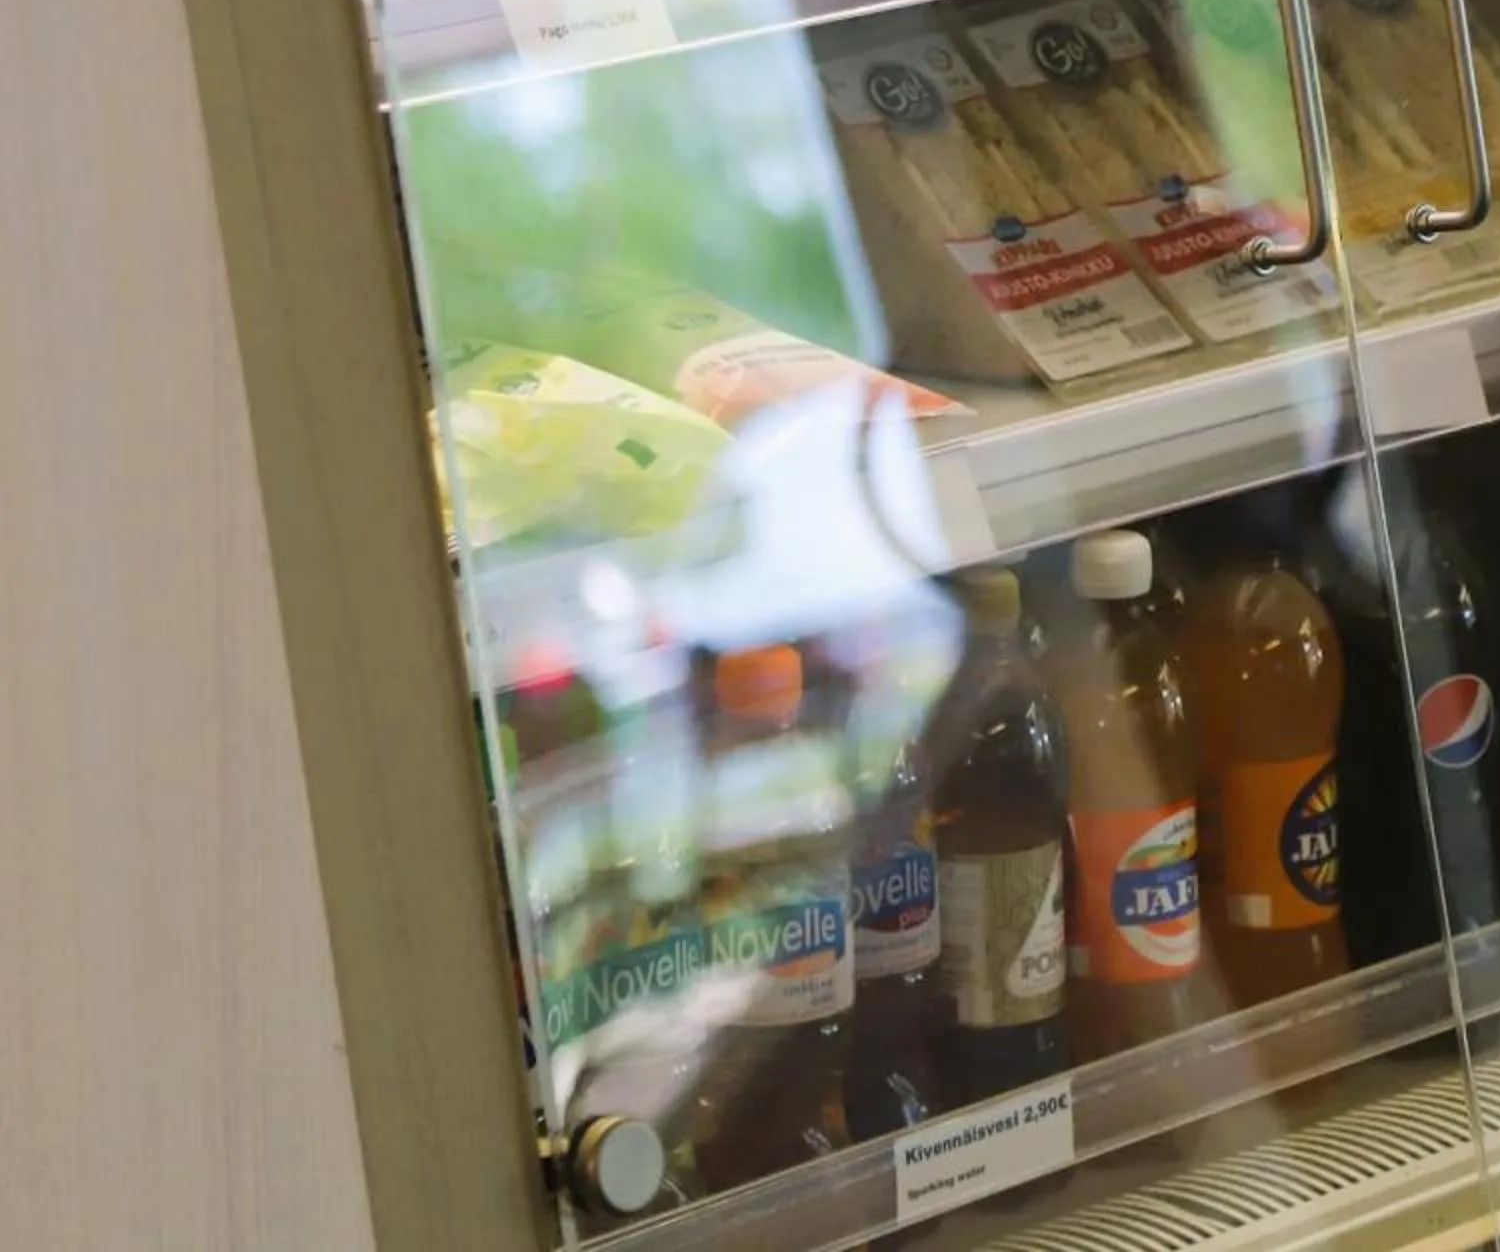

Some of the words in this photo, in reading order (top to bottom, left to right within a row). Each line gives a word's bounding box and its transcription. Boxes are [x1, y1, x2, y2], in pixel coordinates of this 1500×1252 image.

[849, 860, 931, 923] ovelle
[710, 906, 837, 967] Novelle
[582, 938, 699, 1013] Novelle
[1023, 1092, 1069, 1124] 2,90€
